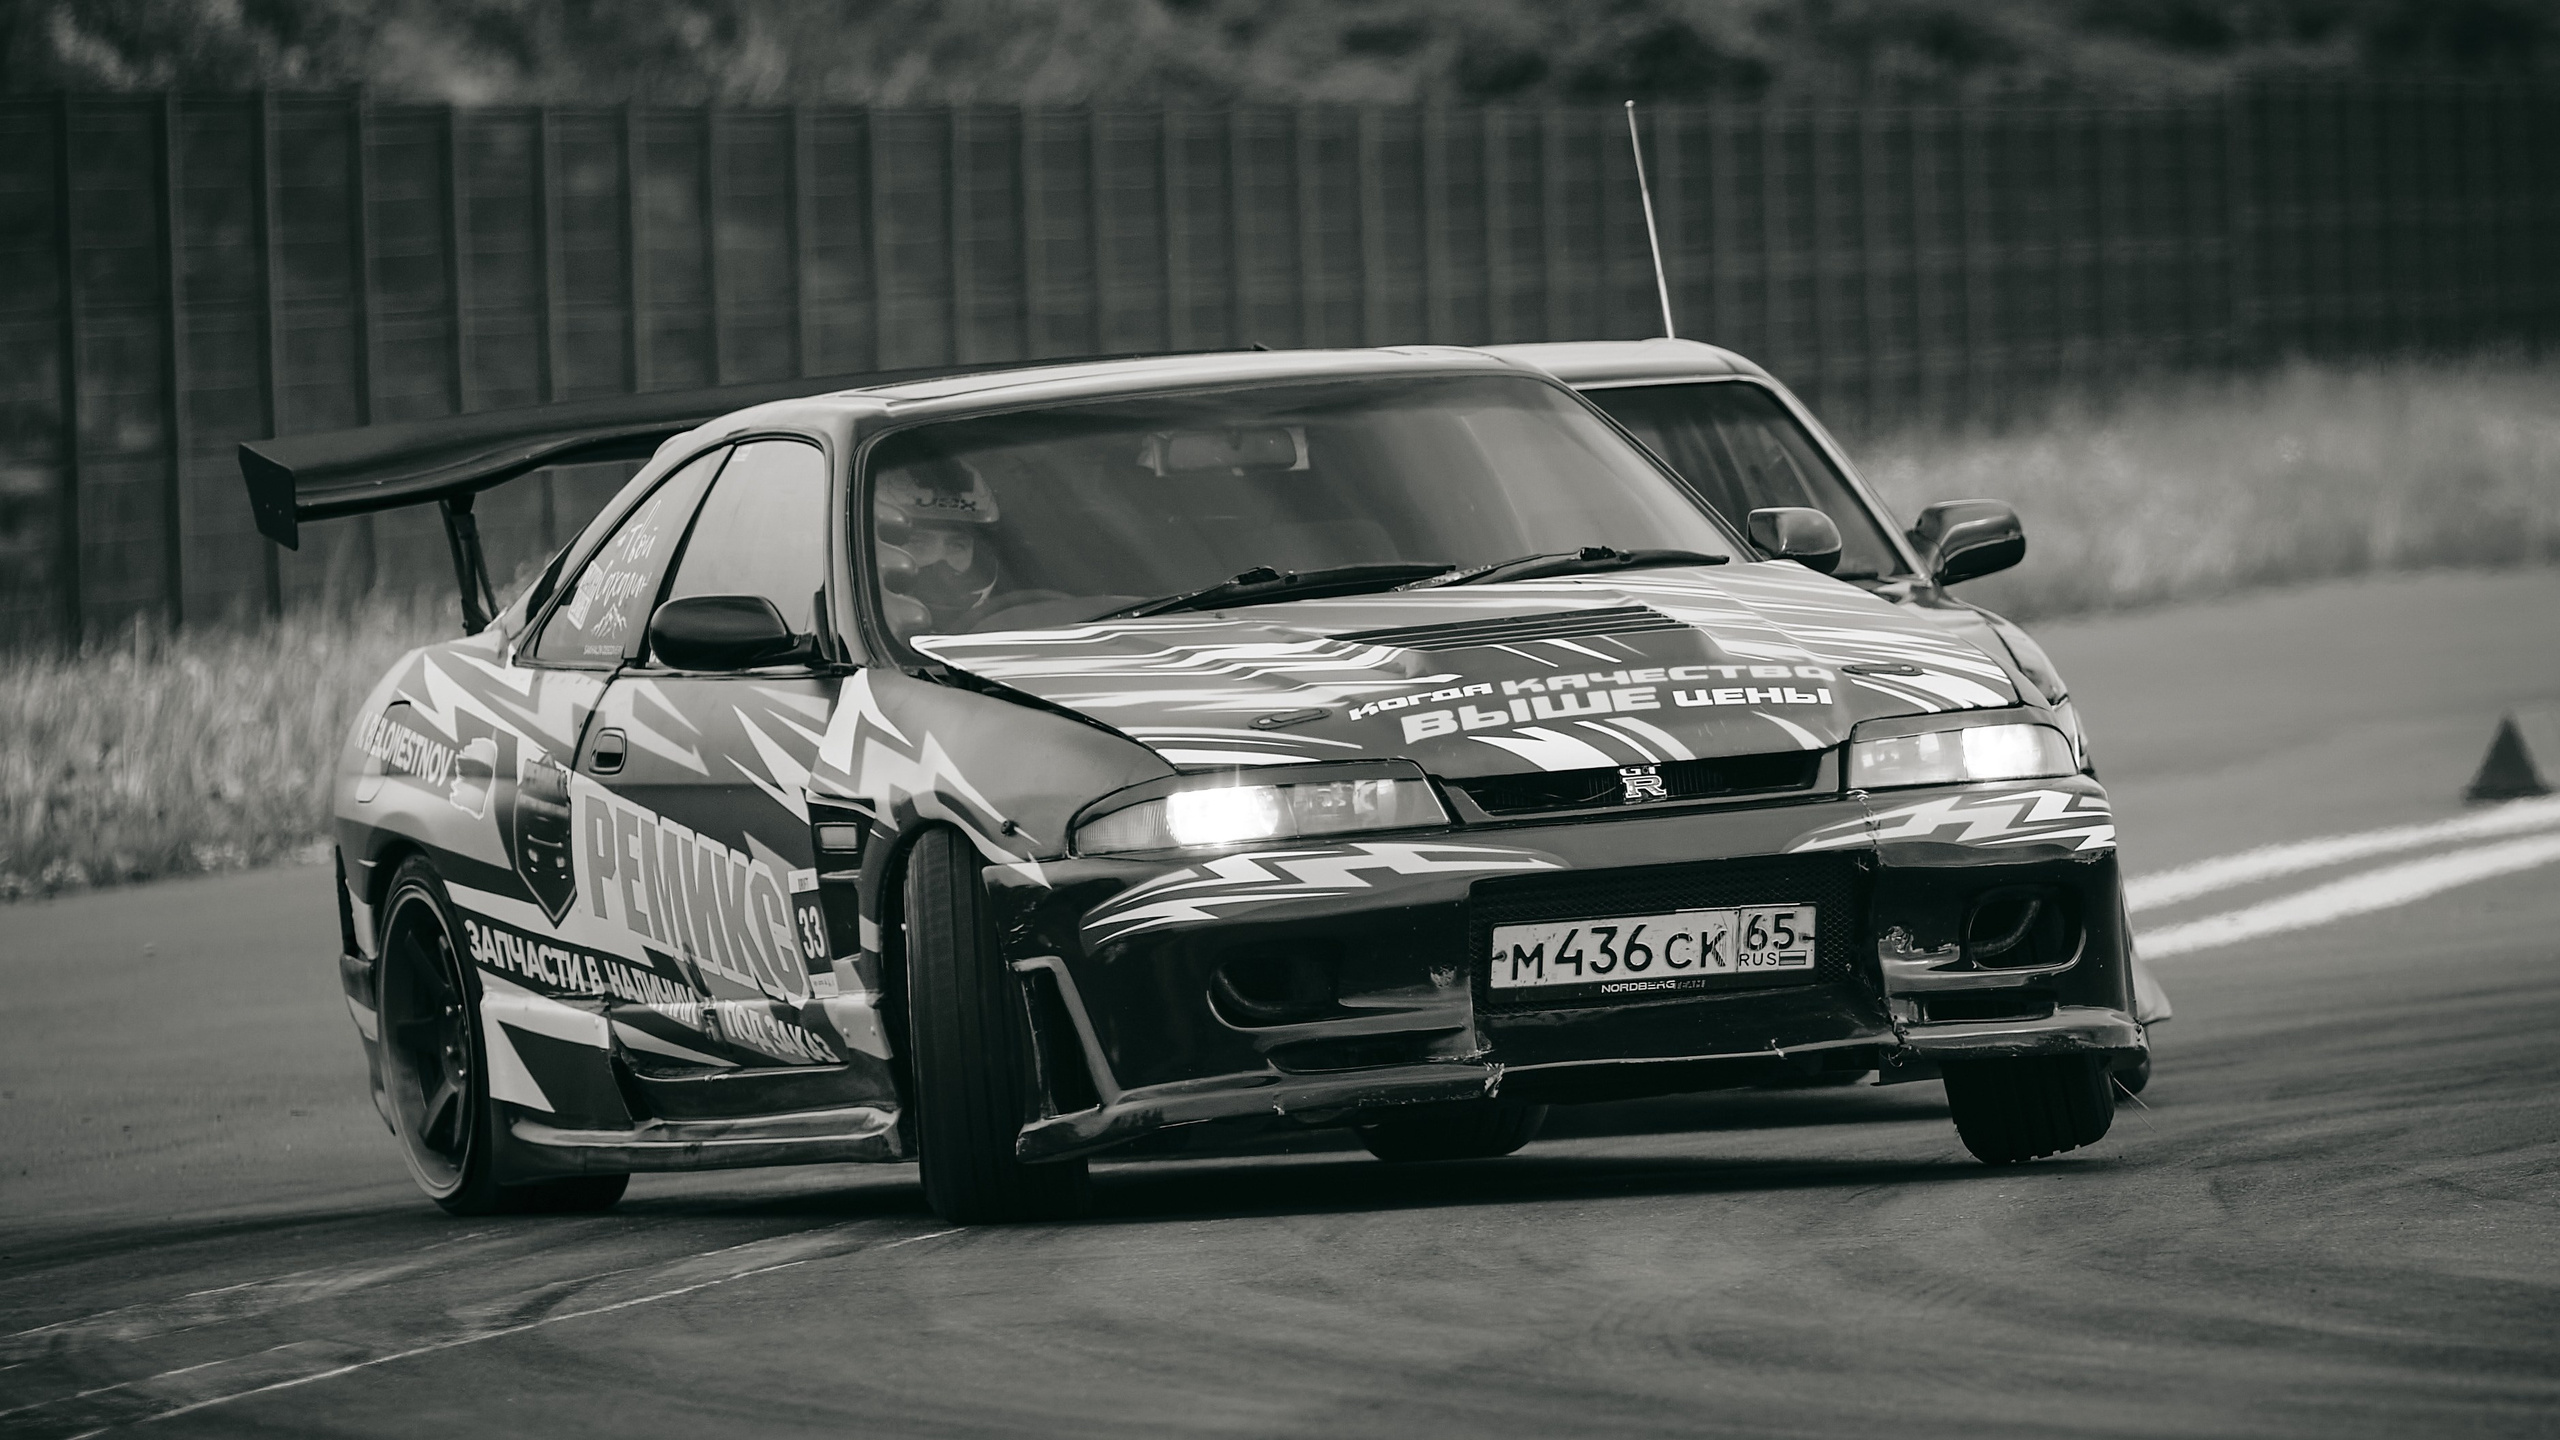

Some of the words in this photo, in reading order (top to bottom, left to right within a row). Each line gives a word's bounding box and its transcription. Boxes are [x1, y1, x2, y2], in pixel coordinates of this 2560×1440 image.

[1501, 665, 1837, 695] КАЧЕСТВО
[1400, 686, 1661, 744] ВЫШЕ
[1672, 687, 1833, 707] ЦЕНЫ
[1622, 775, 1667, 799] R
[583, 793, 807, 999] РЕМИКС
[798, 906, 826, 960] 33
[1747, 912, 1797, 950] 65
[464, 919, 586, 992] ЗАПЧАСТИ
[584, 955, 605, 995] В
[1739, 951, 1777, 967] RUS
[1601, 979, 1676, 994] NORDBERG
[724, 999, 780, 1055] ПОД
[763, 1015, 841, 1063] ЗАКАЗ
